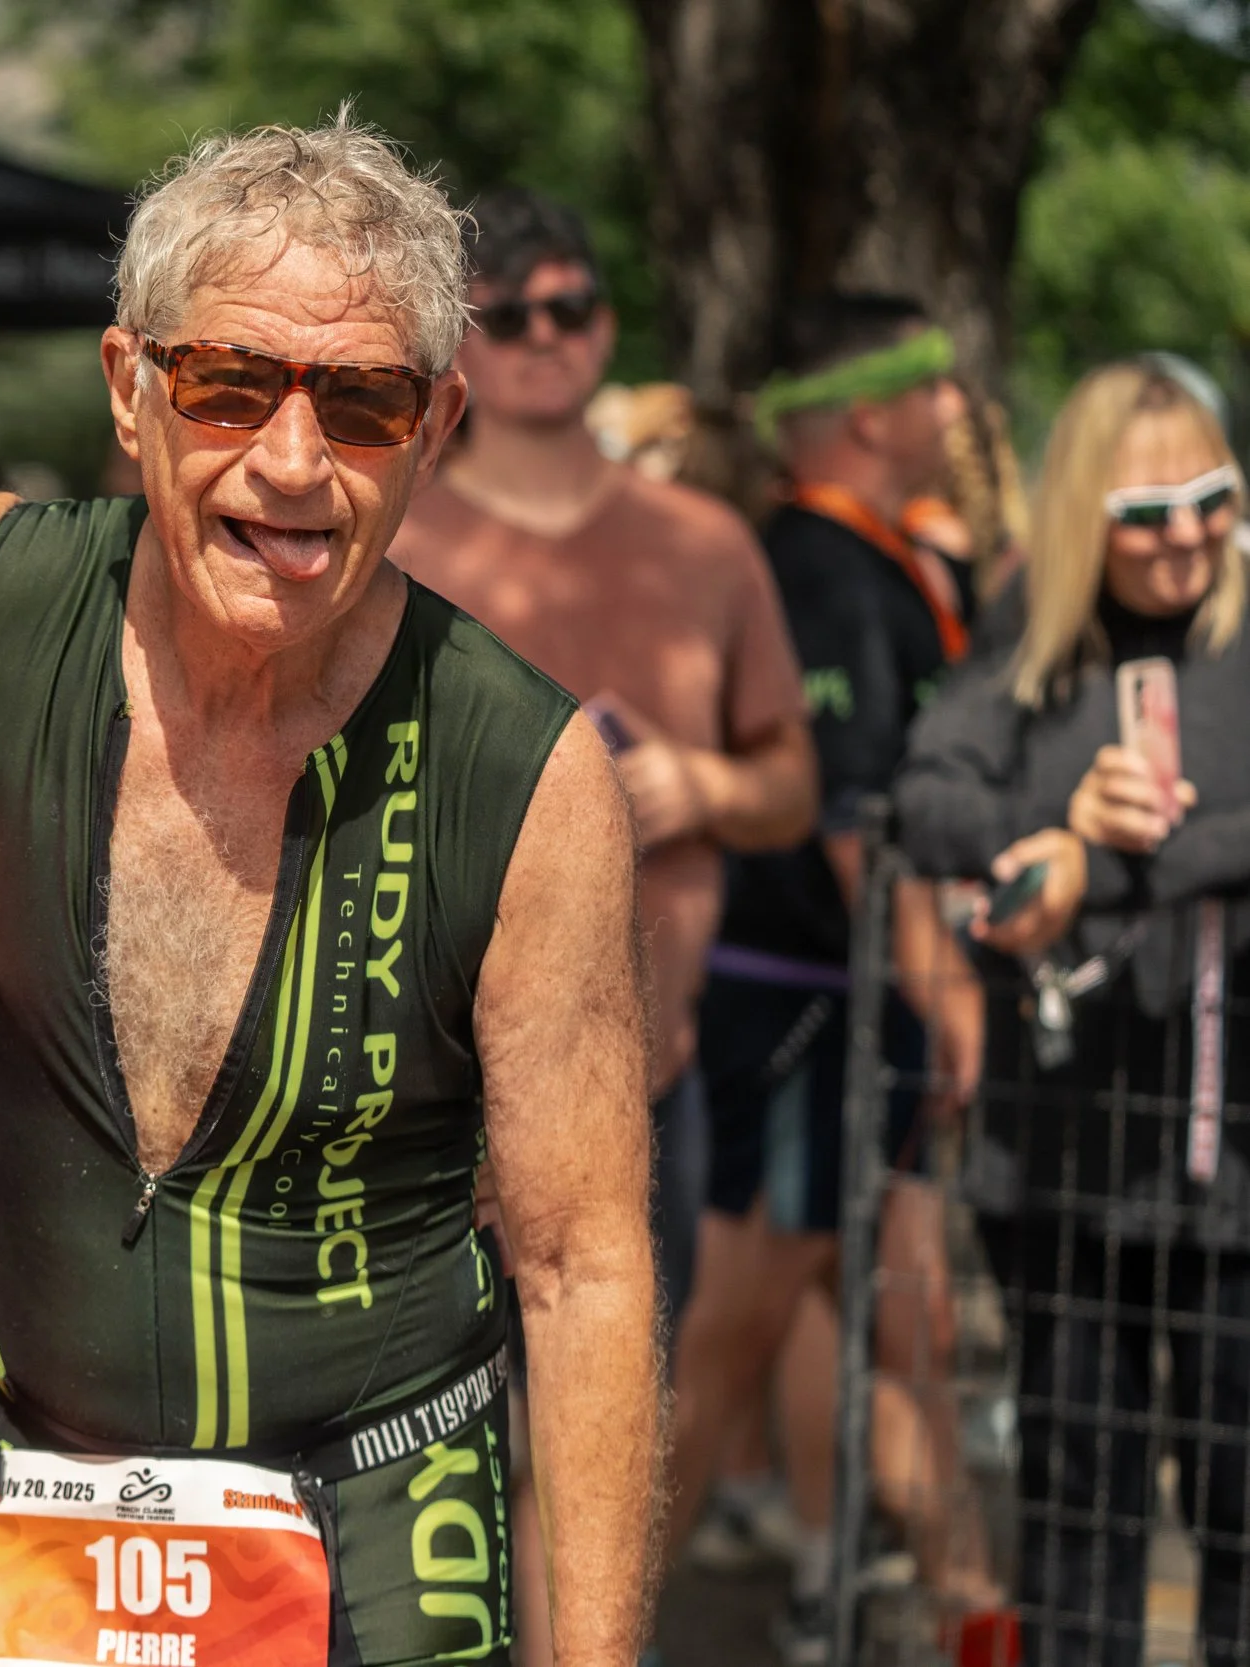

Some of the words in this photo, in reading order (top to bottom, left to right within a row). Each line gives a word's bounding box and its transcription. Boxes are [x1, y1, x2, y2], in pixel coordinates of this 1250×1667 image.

[366, 720, 419, 998] RUDY
[314, 1033, 396, 1309] PROJECT
[25, 1478, 48, 1501] 20,
[53, 1480, 95, 1502] 2025
[223, 1488, 303, 1520] Standard
[84, 1535, 212, 1618] 105
[96, 1628, 196, 1667] PIERRE
